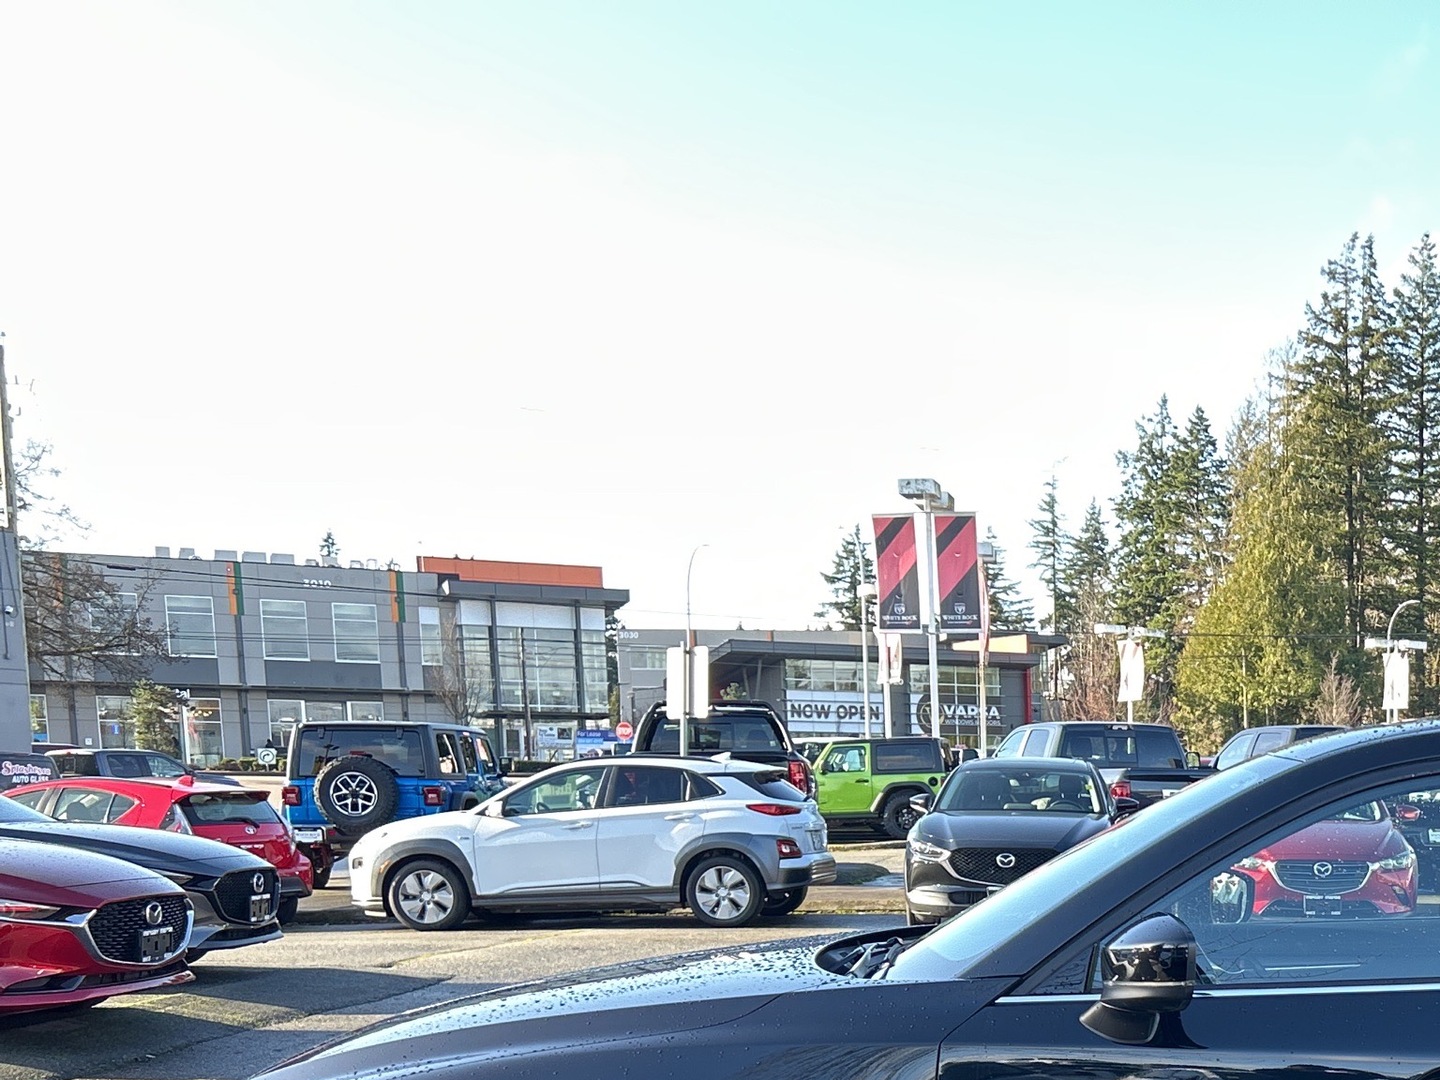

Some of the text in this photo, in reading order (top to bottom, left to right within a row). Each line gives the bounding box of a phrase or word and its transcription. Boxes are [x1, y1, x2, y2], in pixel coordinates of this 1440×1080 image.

[619, 631, 639, 639] 3030
[790, 703, 880, 721] NOW OPEN
[11, 775, 29, 784] AUTO
